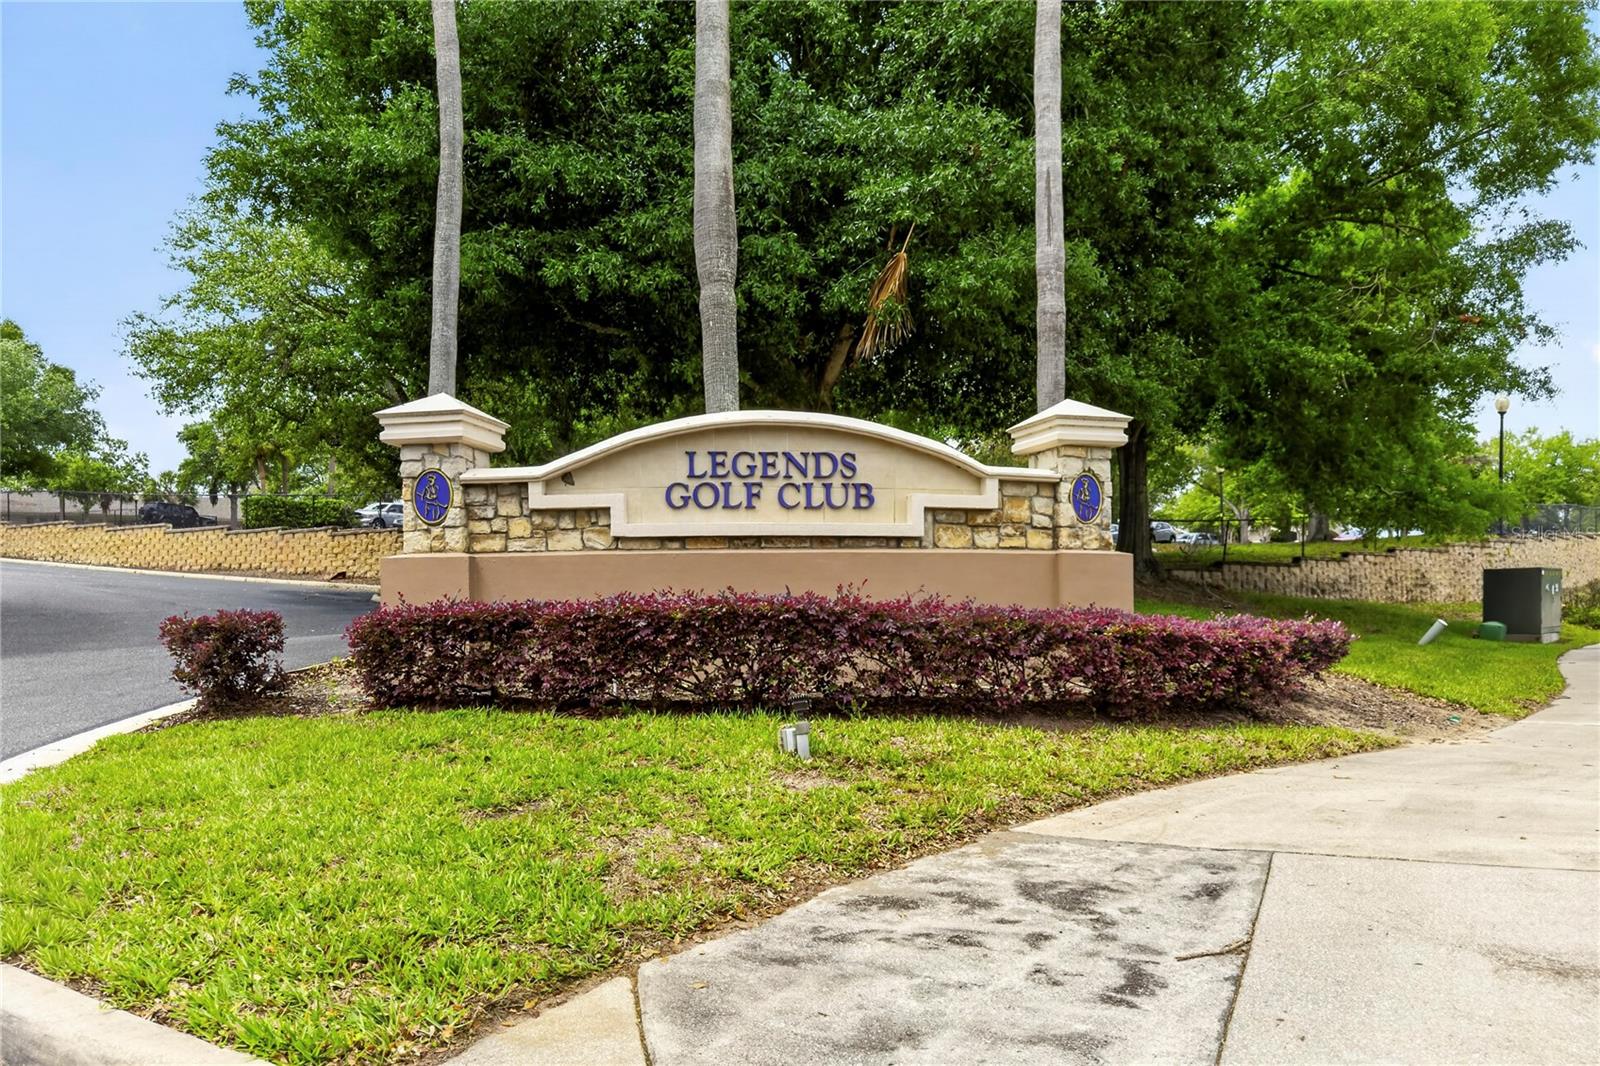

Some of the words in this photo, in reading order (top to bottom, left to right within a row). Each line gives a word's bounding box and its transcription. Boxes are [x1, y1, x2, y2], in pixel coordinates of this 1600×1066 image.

[685, 451, 857, 479] LEGENDS
[665, 482, 763, 510] GOLF
[777, 482, 876, 510] CLUB
